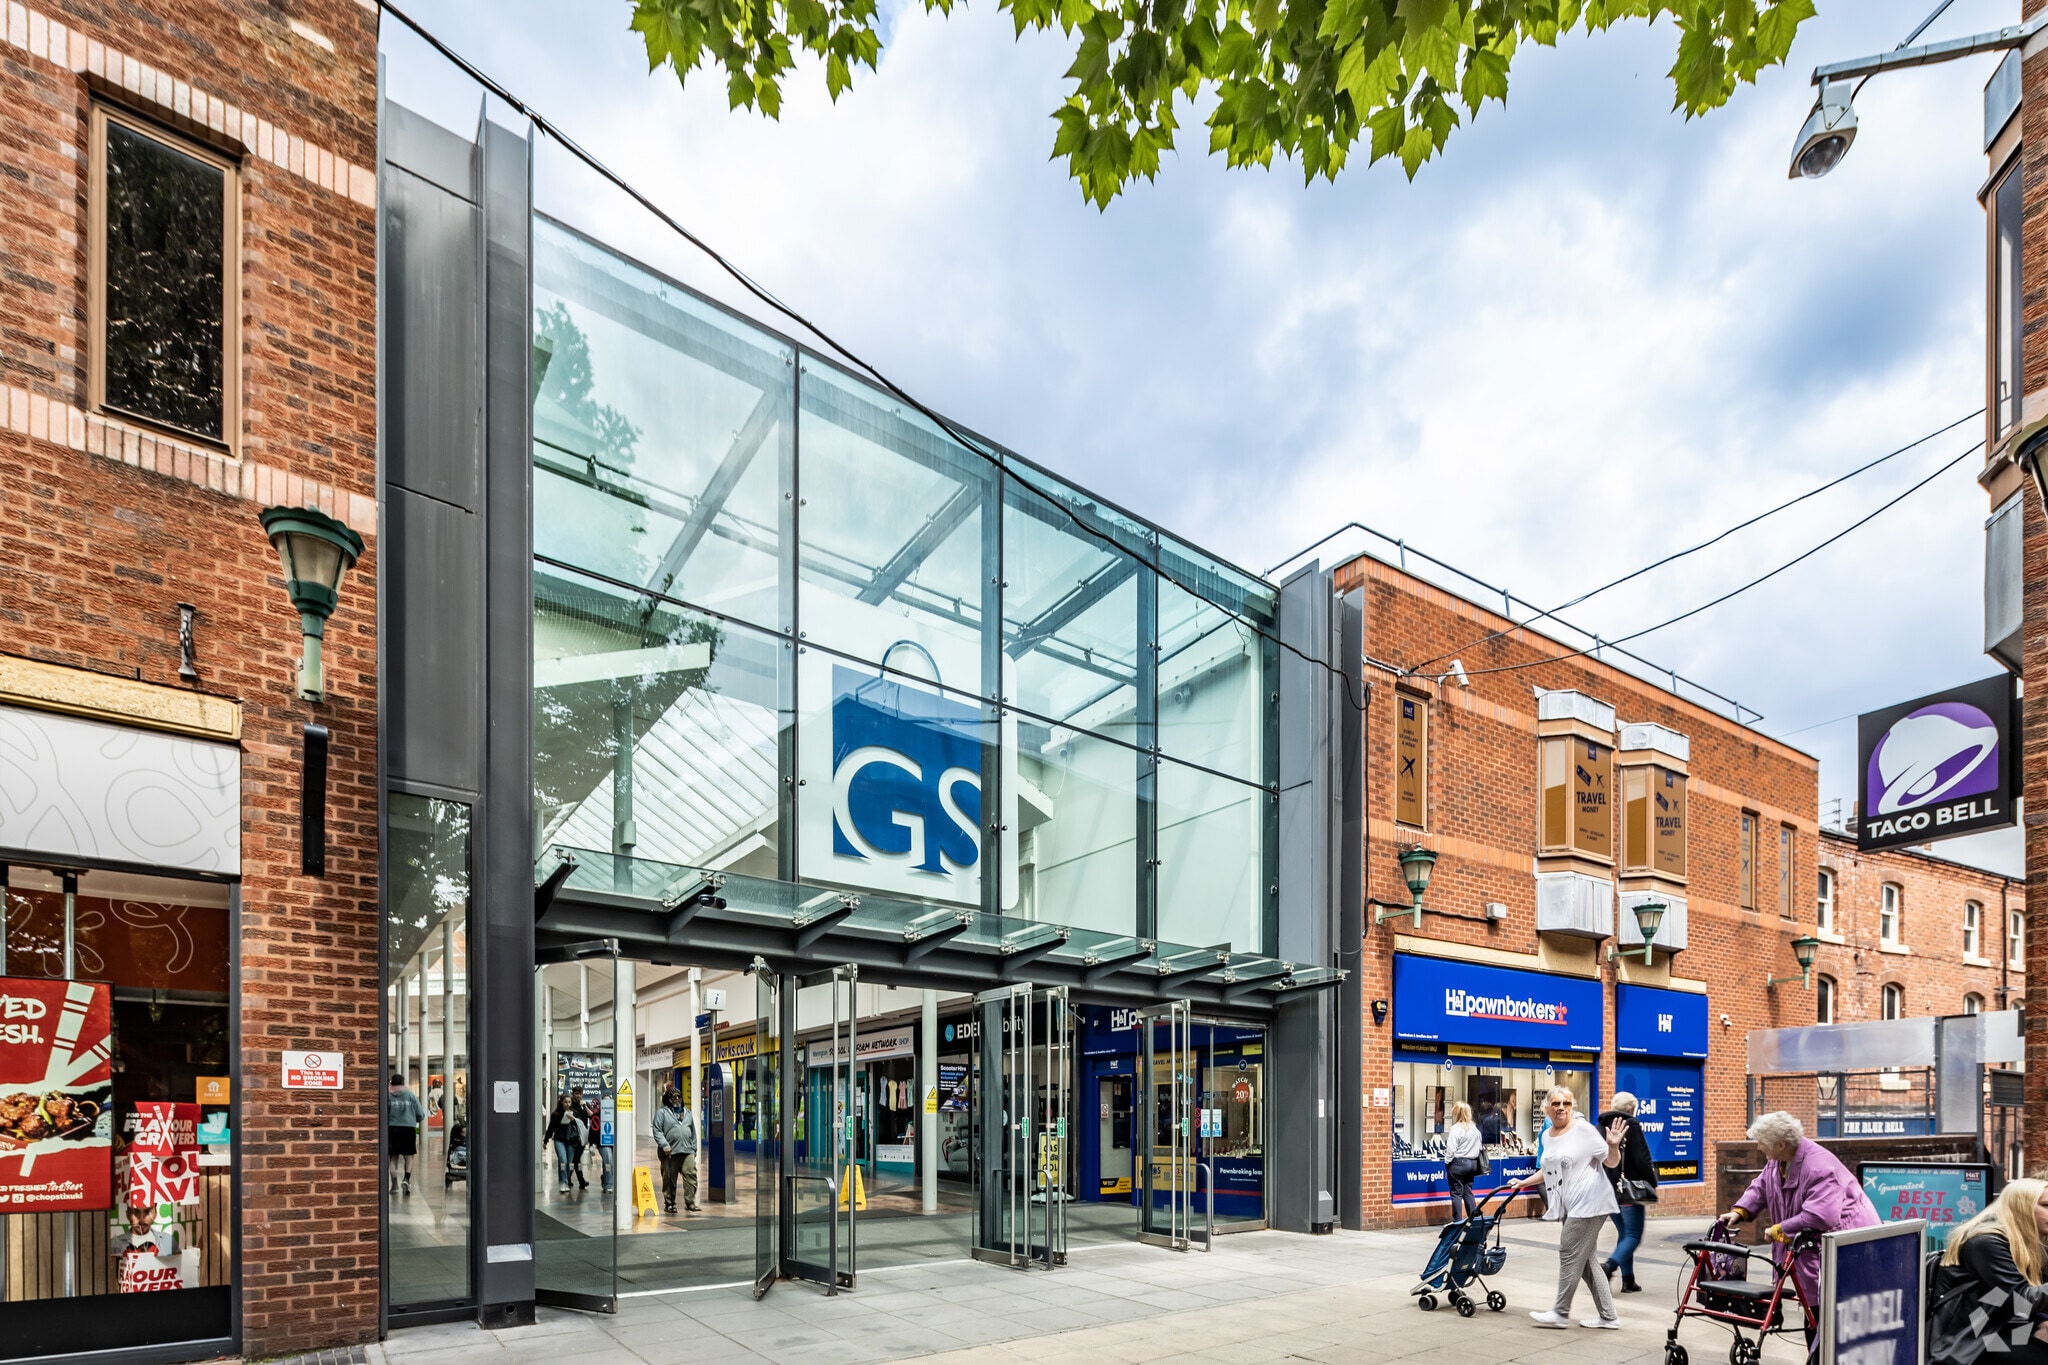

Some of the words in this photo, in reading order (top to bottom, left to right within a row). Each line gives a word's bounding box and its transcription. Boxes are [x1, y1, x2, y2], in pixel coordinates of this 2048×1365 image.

[1577, 791, 1607, 805] TRAVEL
[833, 746, 982, 880] GS
[1582, 805, 1599, 814] MONEY
[1656, 816, 1682, 829] TRAVEL
[1866, 811, 1931, 839] TACO
[1936, 798, 2000, 826] BELL
[1660, 829, 1676, 837] MONEY
[0, 993, 47, 1020] ED
[1445, 988, 1467, 1013] H&T
[1466, 995, 1556, 1020] pawnbrokers
[957, 1021, 980, 1039] EDE
[871, 1038, 898, 1050] NETWORK
[1640, 1099, 1656, 1115] Sell
[123, 1118, 194, 1133] FLAVOUR
[1639, 1121, 1664, 1132] orrow
[1843, 1121, 1860, 1134] THE
[1861, 1121, 1884, 1134] BLUE
[1884, 1121, 1905, 1133] BELL
[134, 1132, 196, 1146] CRAVERS
[1043, 1144, 1058, 1152] CAS
[1042, 1163, 1058, 1172] GOL
[1219, 1167, 1252, 1177] Pawnbroking
[1406, 1171, 1417, 1181] We
[1417, 1170, 1430, 1183] buy
[1430, 1170, 1444, 1183] gold
[8, 1184, 47, 1192] FRESHER
[1878, 1180, 1926, 1196] Guaranteed
[26, 1191, 83, 1202] @chopstixuki
[1897, 1190, 1947, 1206] BEST
[1890, 1205, 1954, 1222] RATES
